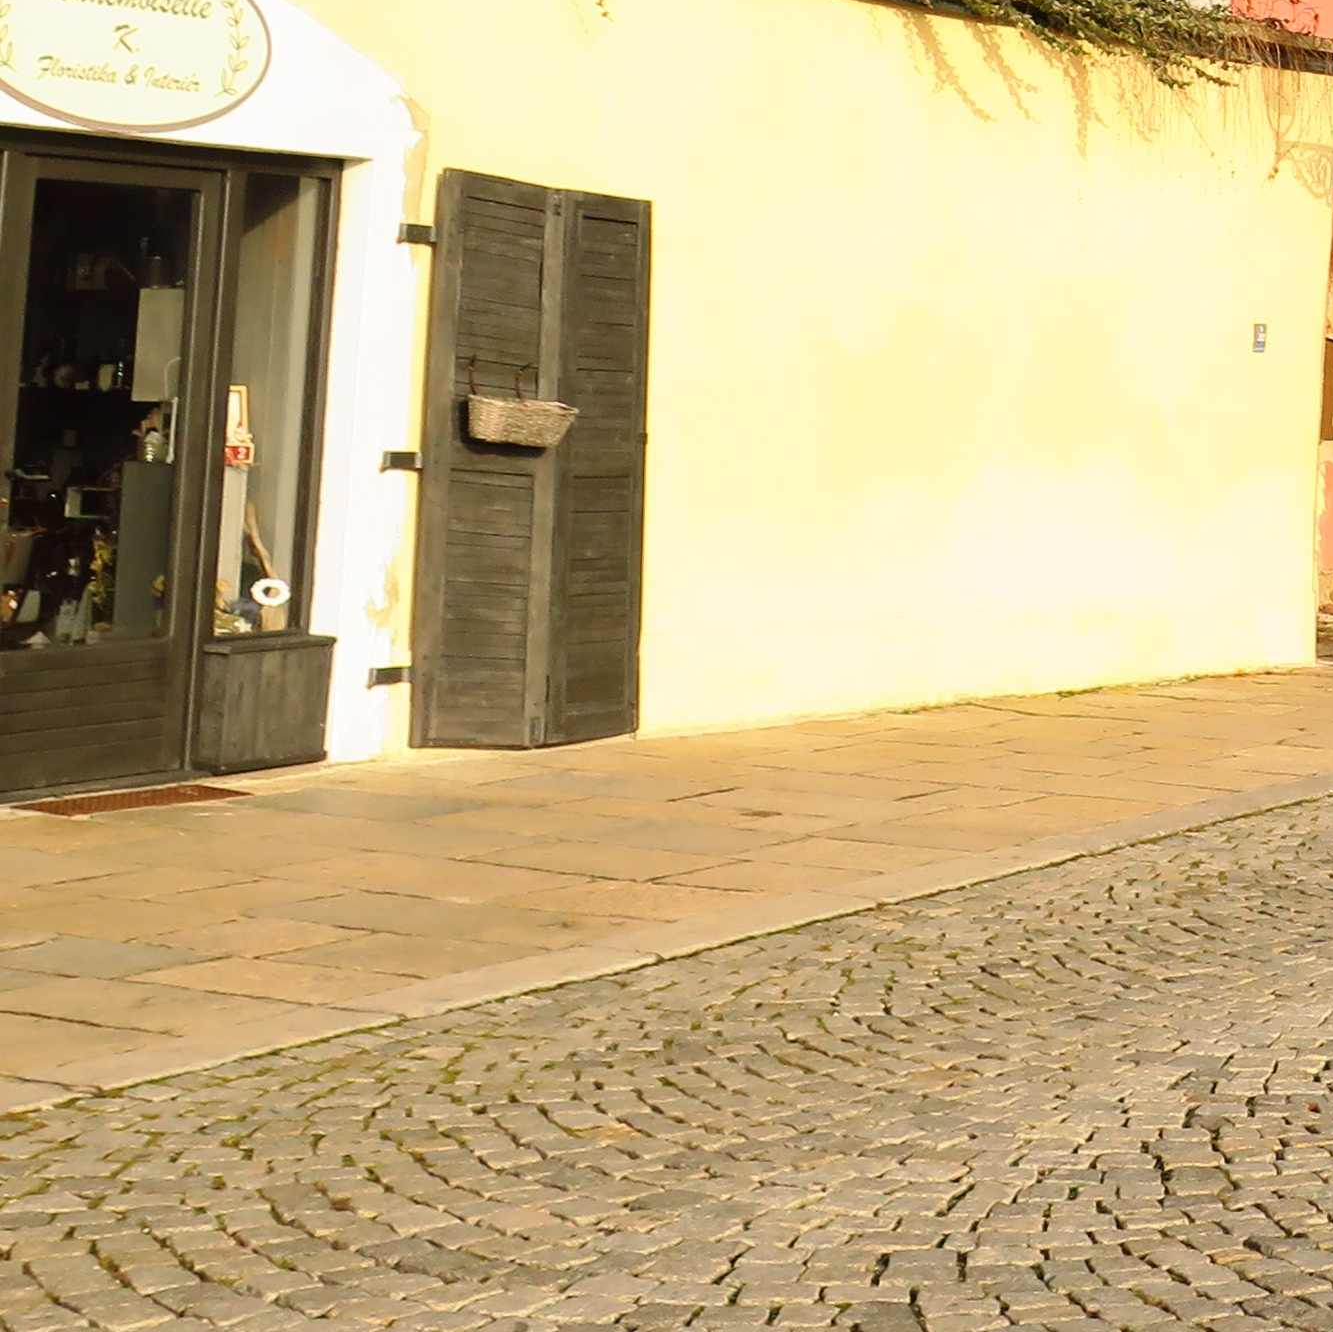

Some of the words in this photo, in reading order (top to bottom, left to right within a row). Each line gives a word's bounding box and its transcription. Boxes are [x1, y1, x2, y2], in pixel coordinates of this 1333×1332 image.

[113, 24, 140, 53] K.
[36, 55, 117, 84] Floristika
[125, 64, 139, 85] &
